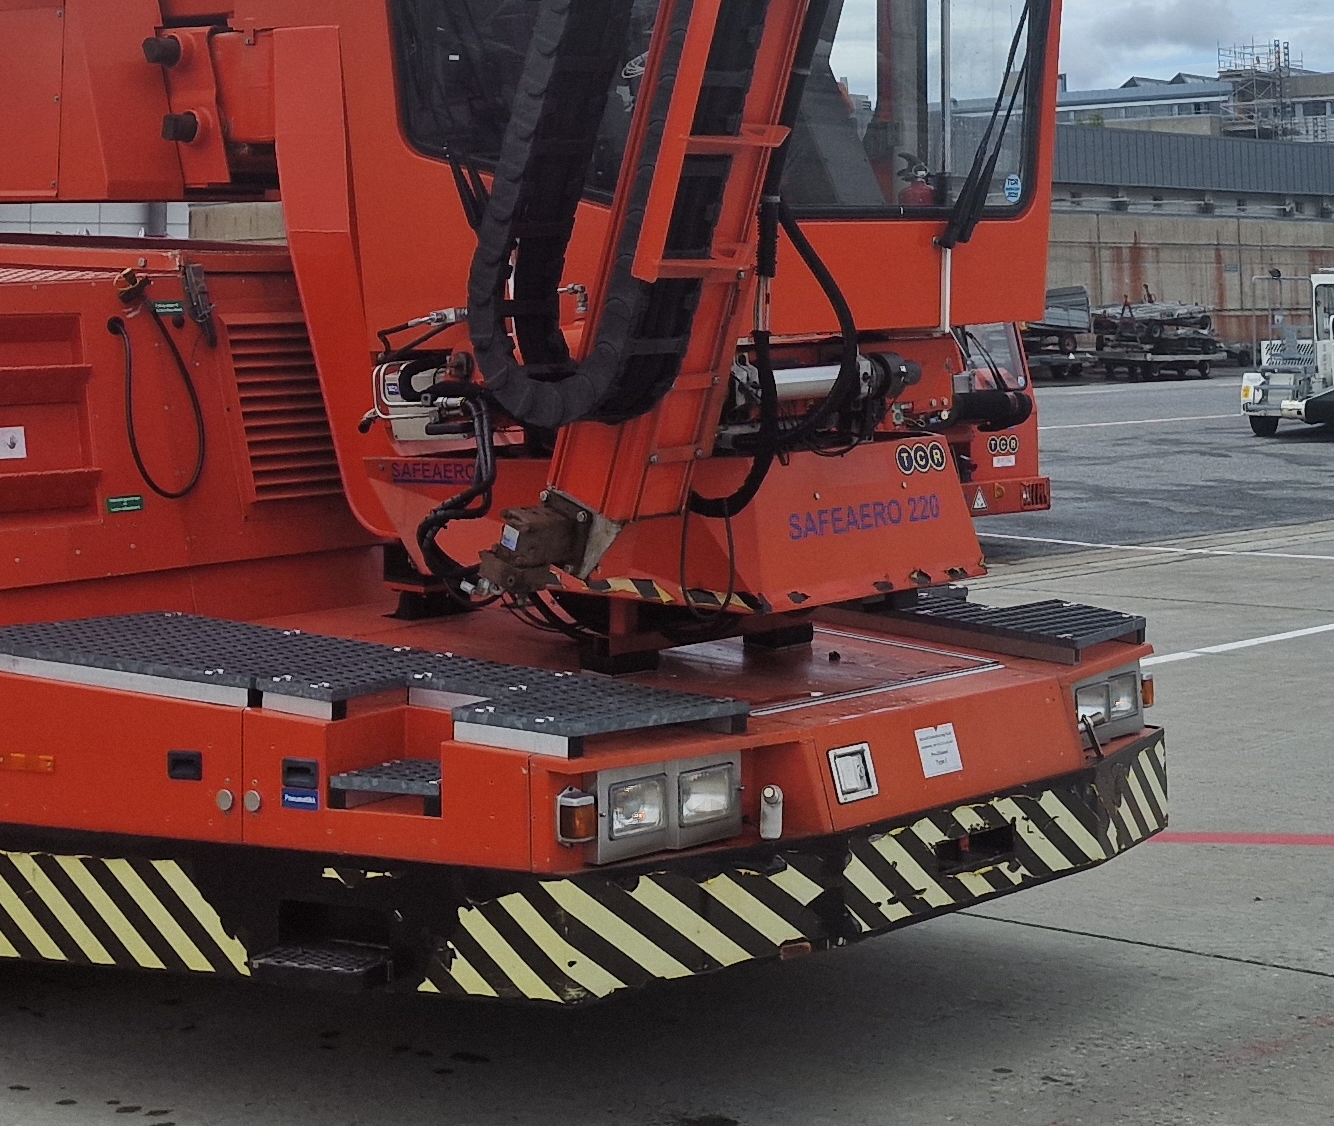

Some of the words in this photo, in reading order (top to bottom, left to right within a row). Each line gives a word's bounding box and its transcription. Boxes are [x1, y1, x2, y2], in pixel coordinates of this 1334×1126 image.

[899, 444, 944, 469] TCR
[990, 438, 1017, 451] TCR
[789, 499, 903, 540] SAFEAERO
[907, 493, 941, 523] 220
